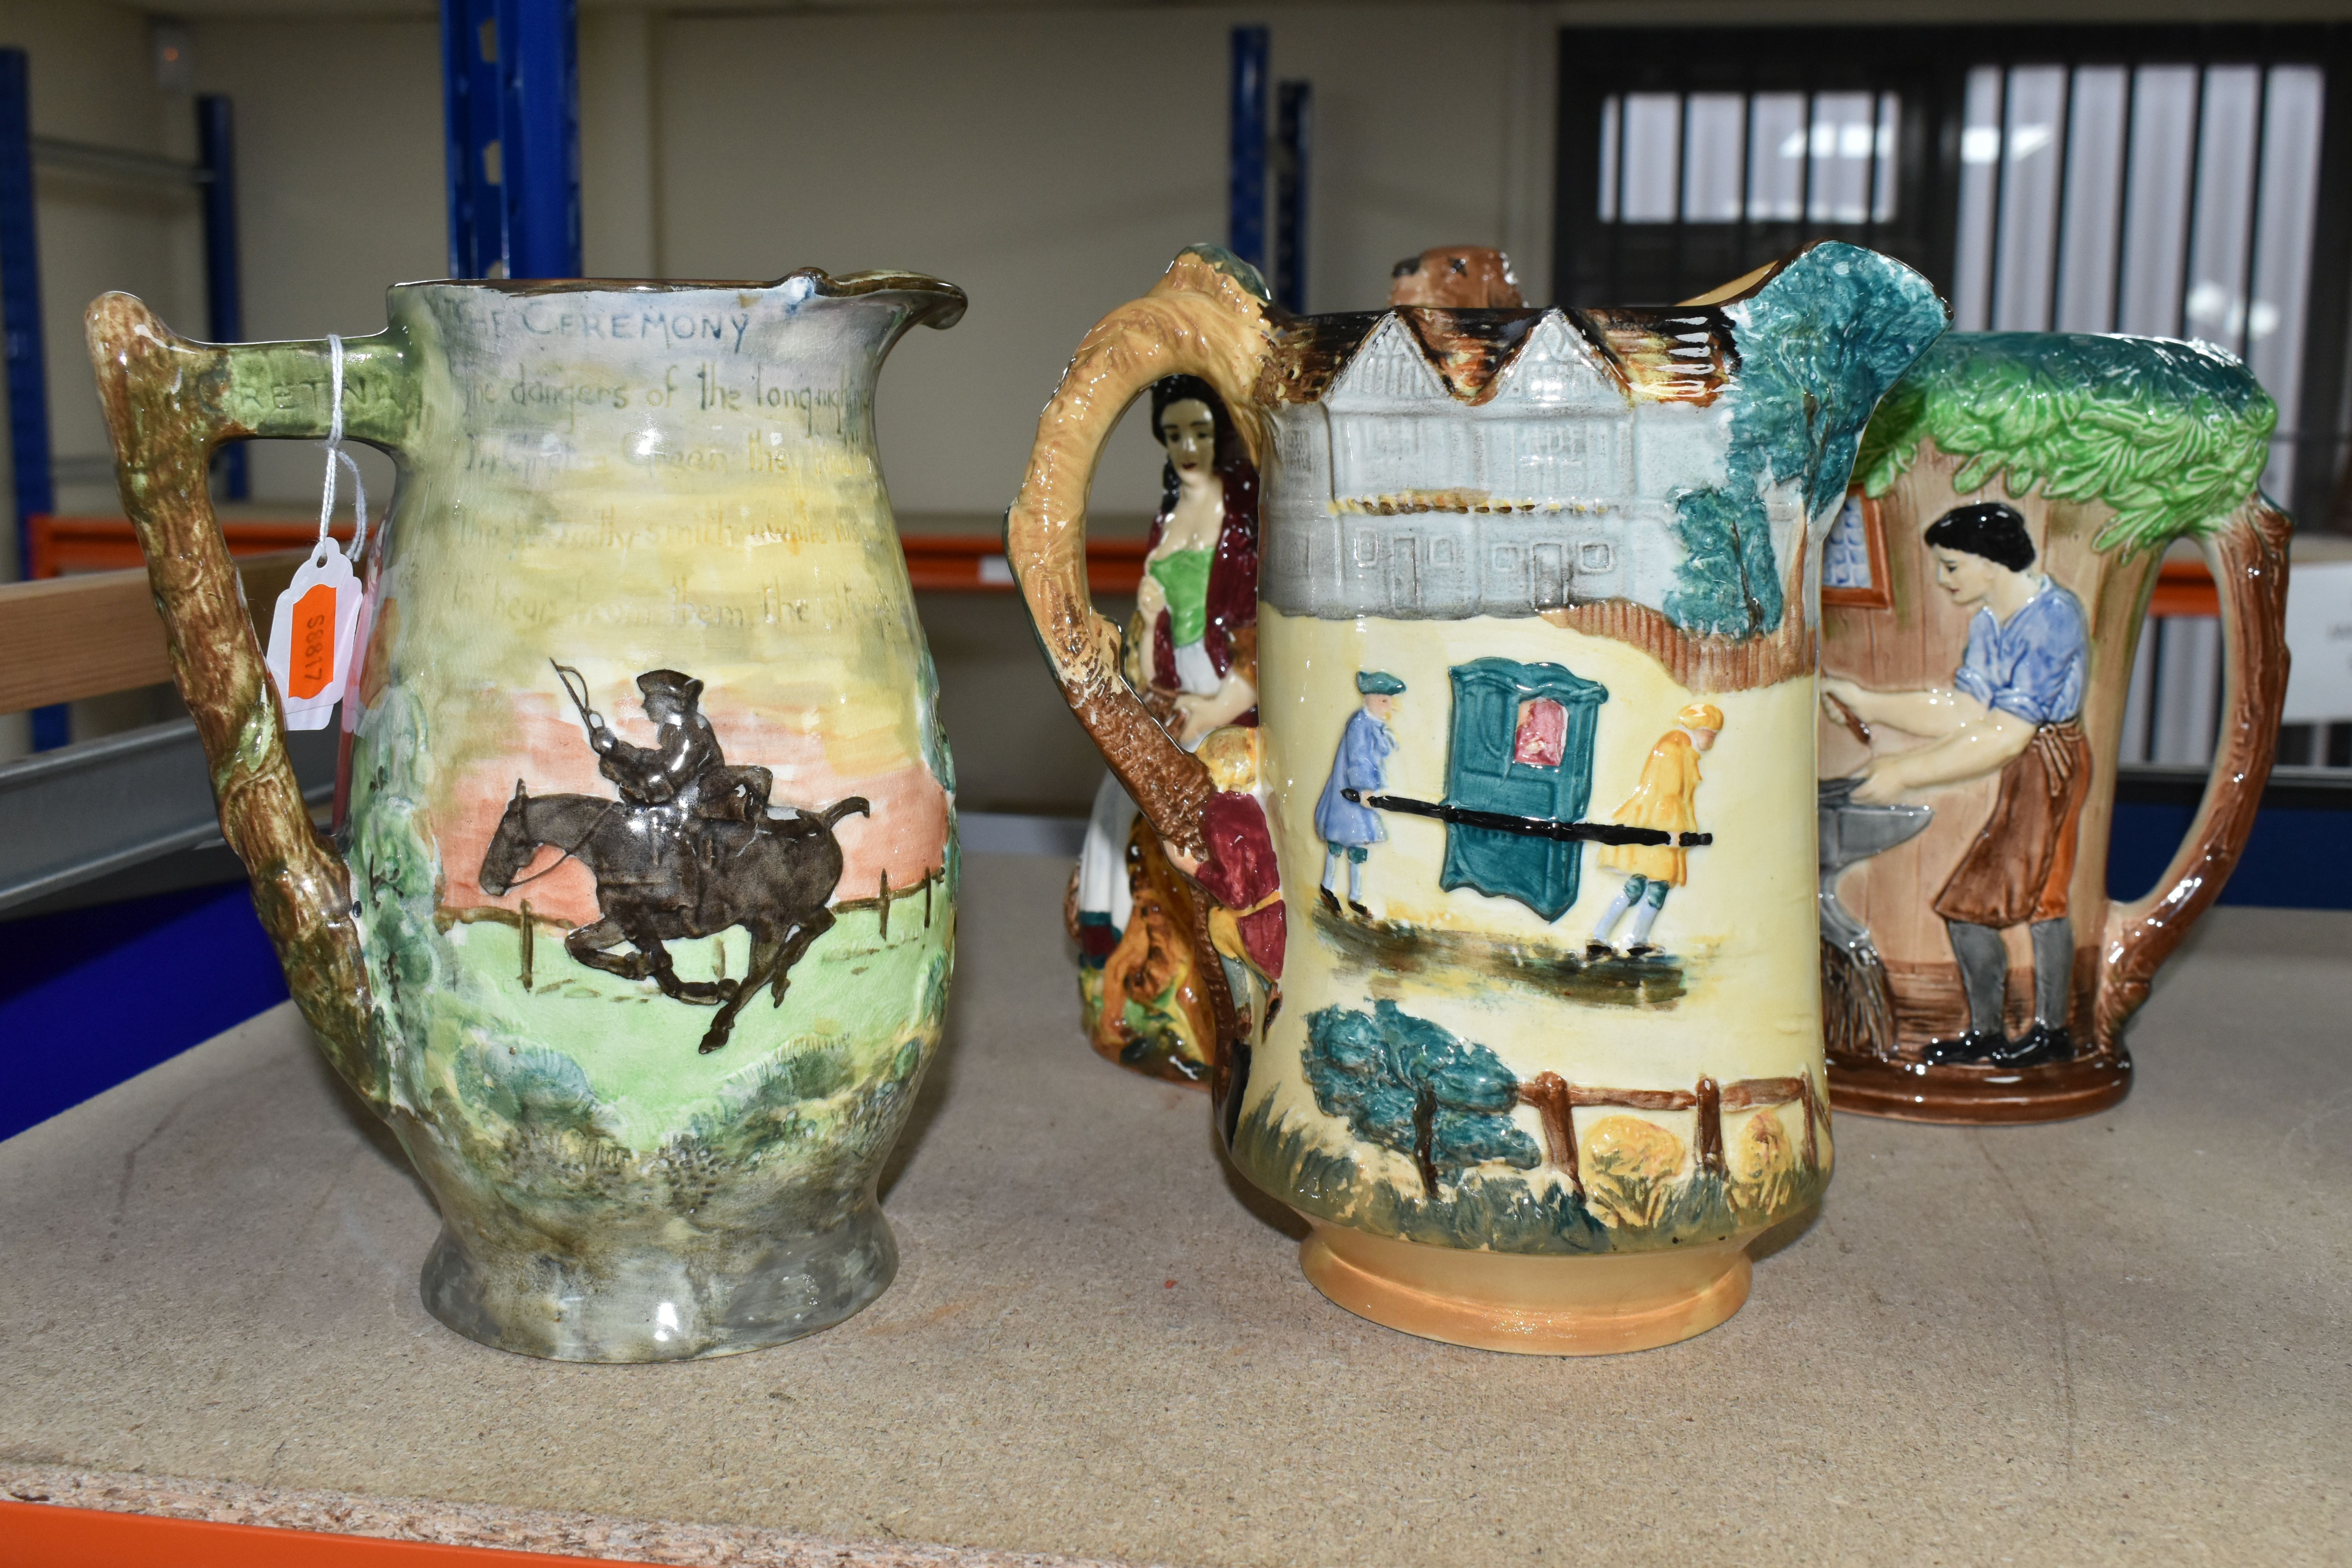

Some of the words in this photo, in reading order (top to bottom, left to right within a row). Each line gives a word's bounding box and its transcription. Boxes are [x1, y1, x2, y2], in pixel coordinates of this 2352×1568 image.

[521, 299, 750, 354] CEREMONY
[511, 361, 630, 434] dangers
[646, 364, 680, 409] of
